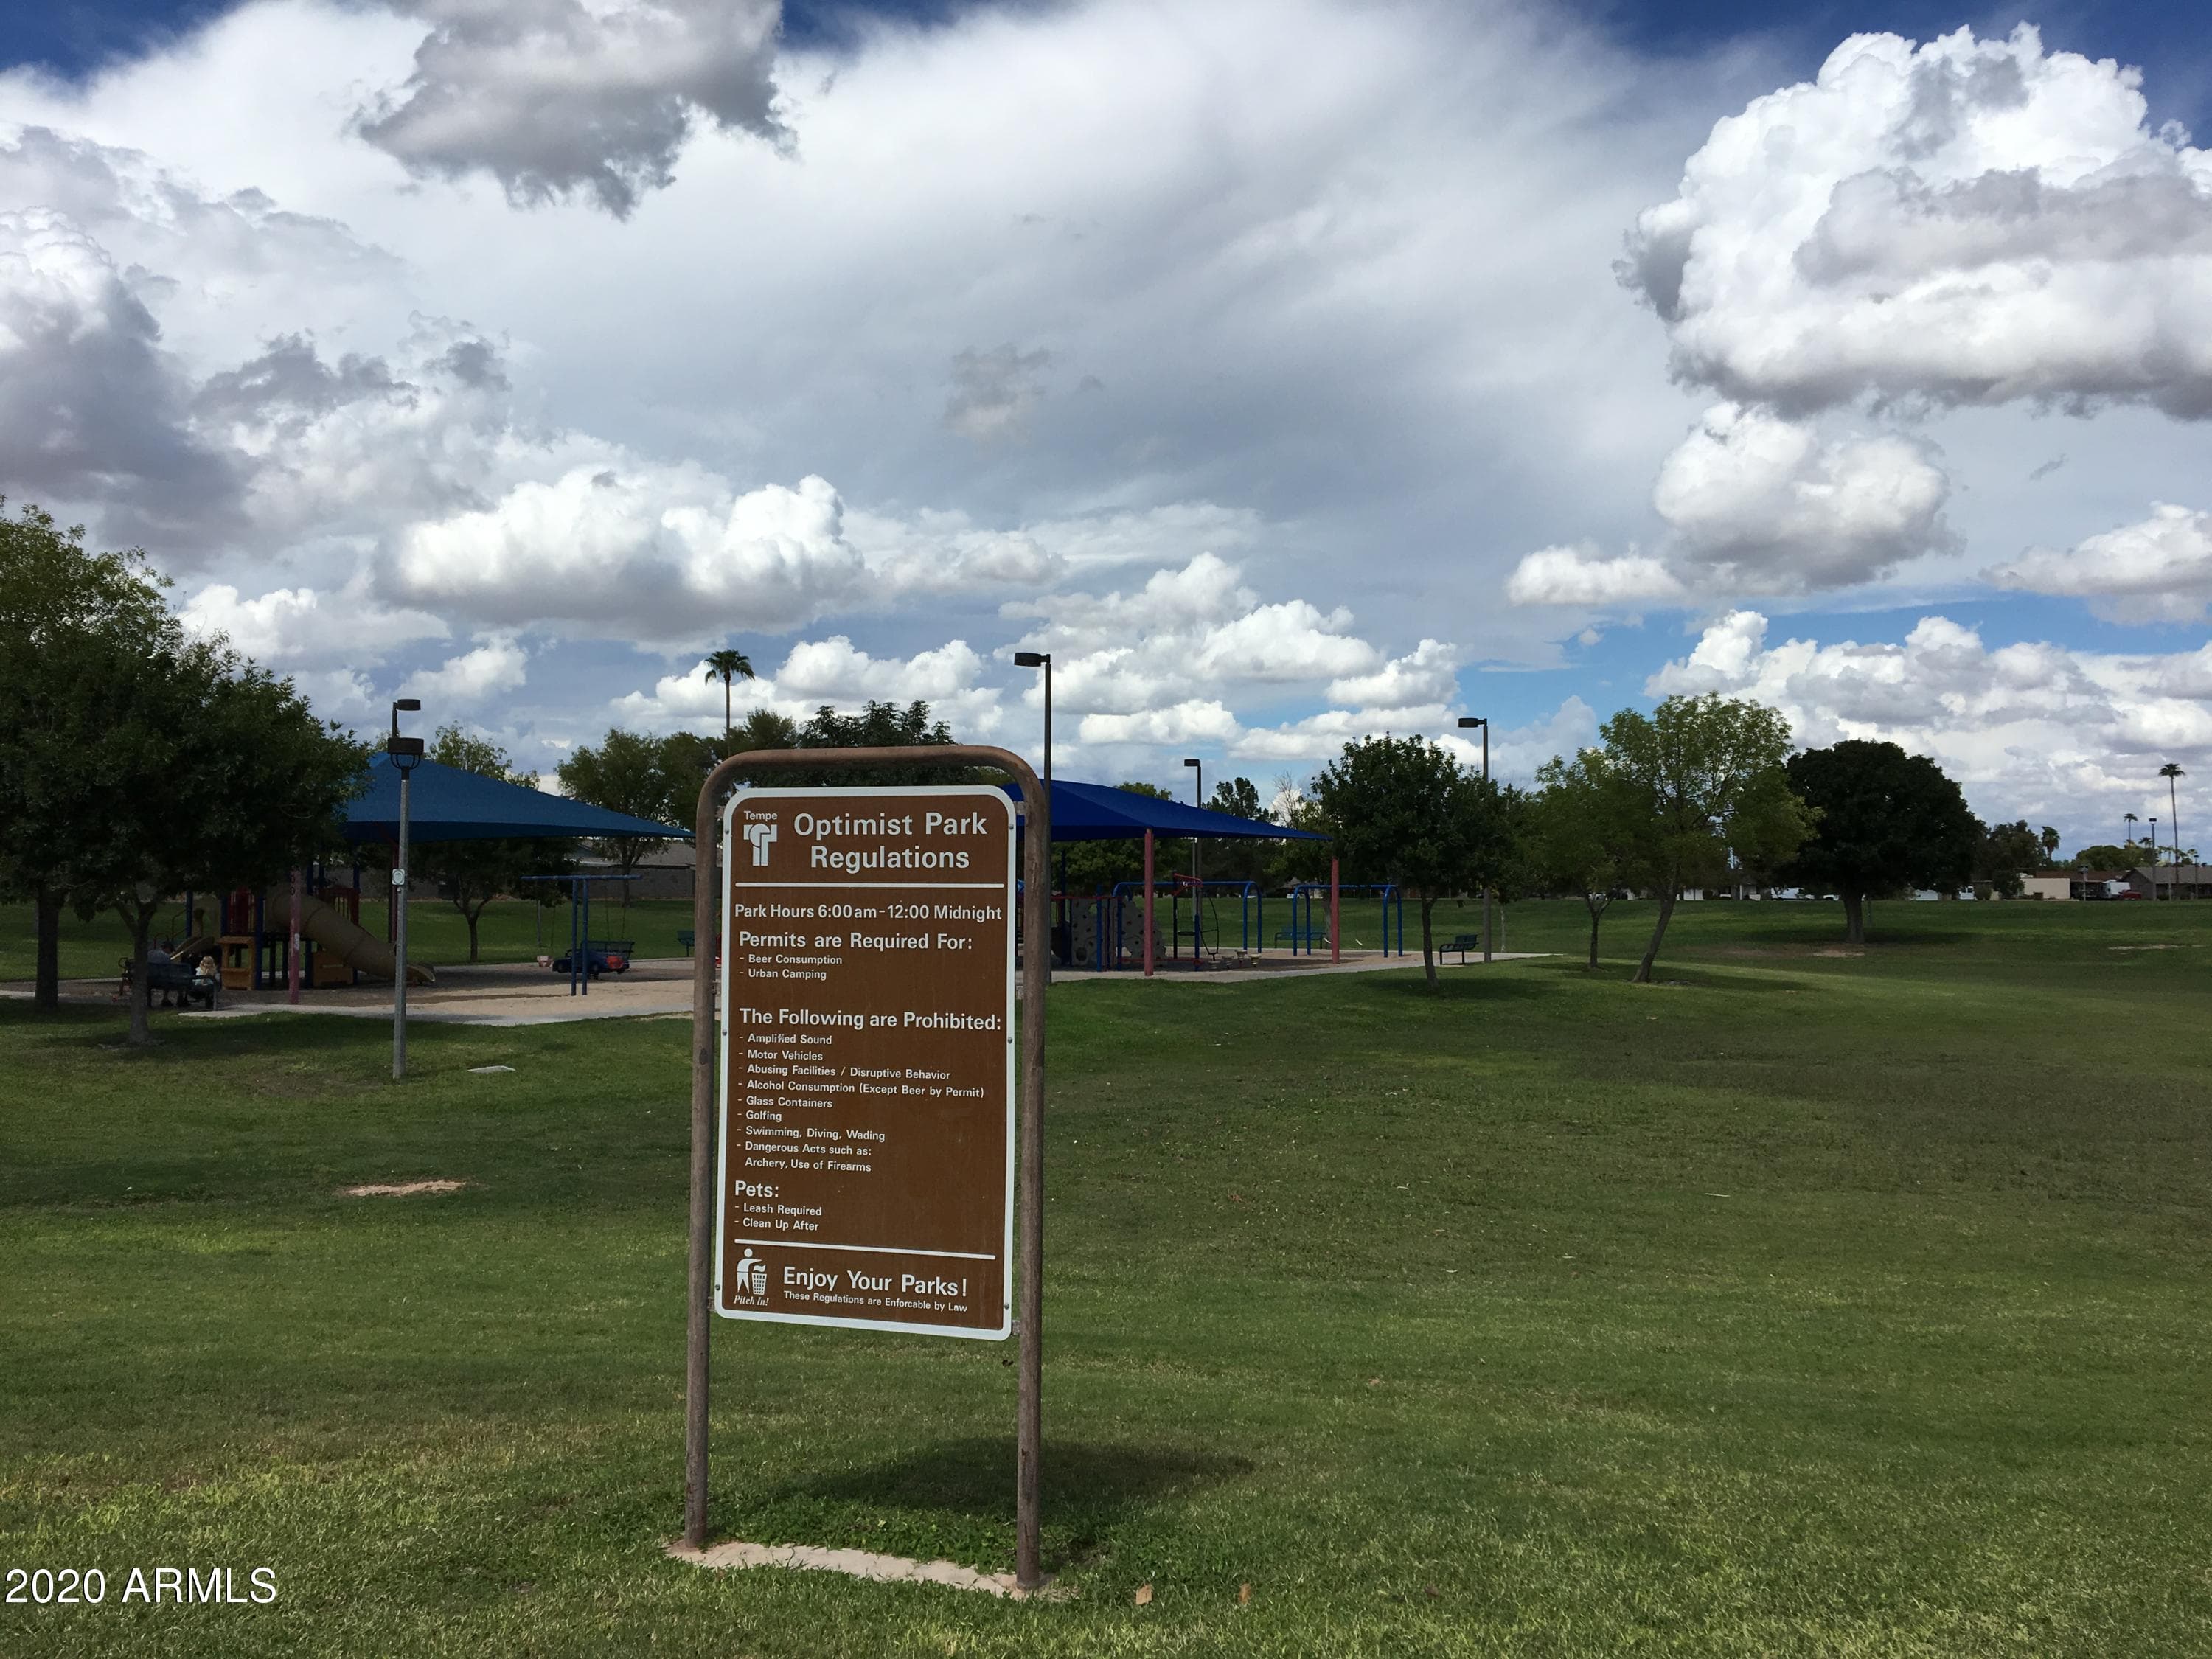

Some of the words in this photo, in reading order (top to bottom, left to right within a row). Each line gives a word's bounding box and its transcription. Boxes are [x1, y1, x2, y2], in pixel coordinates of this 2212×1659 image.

[744, 811, 777, 821] Tempe
[794, 813, 912, 840] Optimist
[926, 812, 987, 835] Park
[811, 846, 969, 874] Regulations
[735, 904, 767, 917] Park
[771, 905, 814, 917] Hours
[934, 905, 1001, 922] Midnight
[740, 931, 806, 947] Permits
[815, 936, 841, 947] are
[851, 933, 928, 951] Required
[938, 933, 971, 949] For:
[749, 954, 772, 963] Beer
[776, 955, 842, 965] Consumption
[748, 969, 778, 977] Urban
[782, 969, 826, 981] Camping
[740, 1008, 773, 1023] The
[779, 1009, 863, 1030] Following
[870, 1015, 897, 1026] are
[904, 1012, 1001, 1029] Prohibited:
[748, 1034, 796, 1044] Amplified
[801, 1034, 832, 1044] Sound
[748, 1050, 778, 1059] Motor
[782, 1050, 823, 1060] Vehicles
[747, 1064, 787, 1076] Abusing
[793, 1065, 835, 1076] Facilities
[850, 1068, 901, 1079] Disruptive
[906, 1069, 950, 1079] Behavior
[747, 1080, 784, 1090] Alcohol
[788, 1081, 855, 1093] Consumption
[860, 1083, 897, 1096] (Except
[902, 1085, 925, 1095] Beer
[930, 1086, 942, 1097] by
[946, 1087, 984, 1098] Permit)
[747, 1096, 773, 1105] Glass
[778, 1097, 832, 1107] Containers
[746, 1110, 782, 1122] Golfing
[746, 1126, 801, 1138] Swimming,
[807, 1128, 841, 1140] Diving,
[846, 1130, 885, 1142] Wading
[745, 1141, 799, 1153] Dangerous
[802, 1144, 826, 1153] Acts
[829, 1145, 852, 1155] such
[745, 1157, 788, 1169] Archery,
[791, 1159, 810, 1169] Use
[813, 1161, 824, 1169] of
[828, 1161, 871, 1172] Firearms
[735, 1180, 779, 1197] Pets:
[744, 1203, 773, 1213] Leash
[778, 1205, 821, 1216] Required
[743, 1217, 771, 1228] Clean
[776, 1220, 789, 1231] Up
[793, 1220, 818, 1231] After
[784, 1267, 838, 1291] Enjoy
[847, 1270, 892, 1290] Your
[902, 1274, 967, 1296] Parks!
[734, 1295, 754, 1305] Pitch
[757, 1297, 769, 1306] In!
[784, 1290, 810, 1300] These
[813, 1293, 863, 1304] Regulations
[886, 1298, 931, 1309] Enforcable
[934, 1301, 945, 1312] by
[949, 1302, 967, 1312] Law
